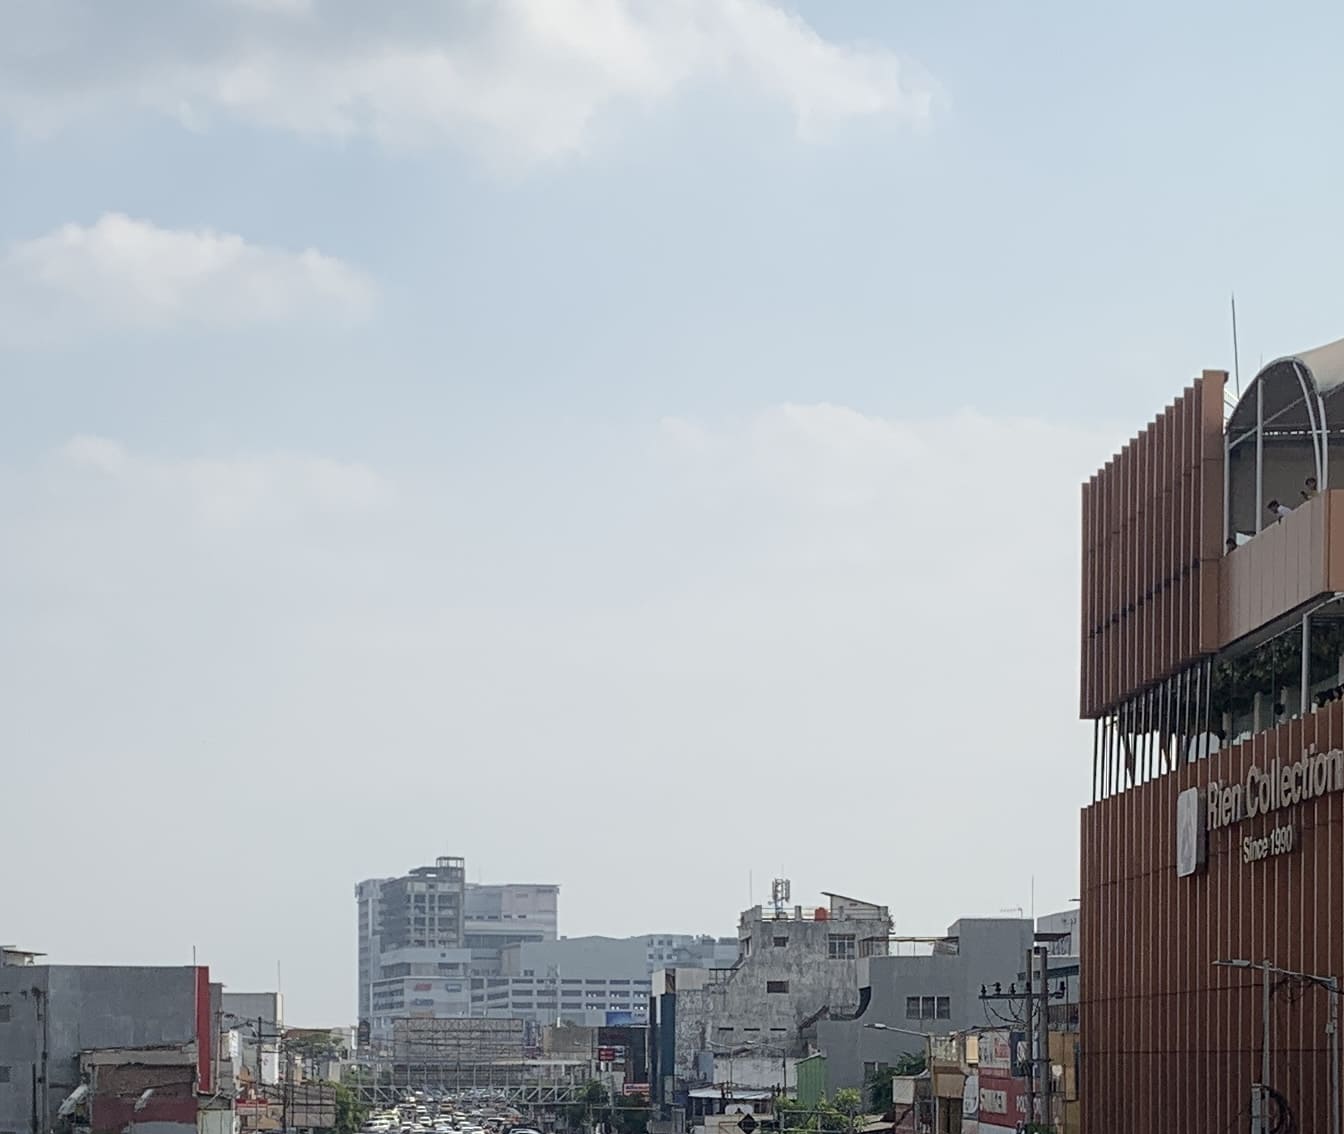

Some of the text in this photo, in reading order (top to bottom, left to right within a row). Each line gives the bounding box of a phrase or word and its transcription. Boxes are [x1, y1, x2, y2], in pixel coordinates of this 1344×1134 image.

[1207, 743, 1344, 831] Rien Collection
[1243, 824, 1293, 864] Since 1990
